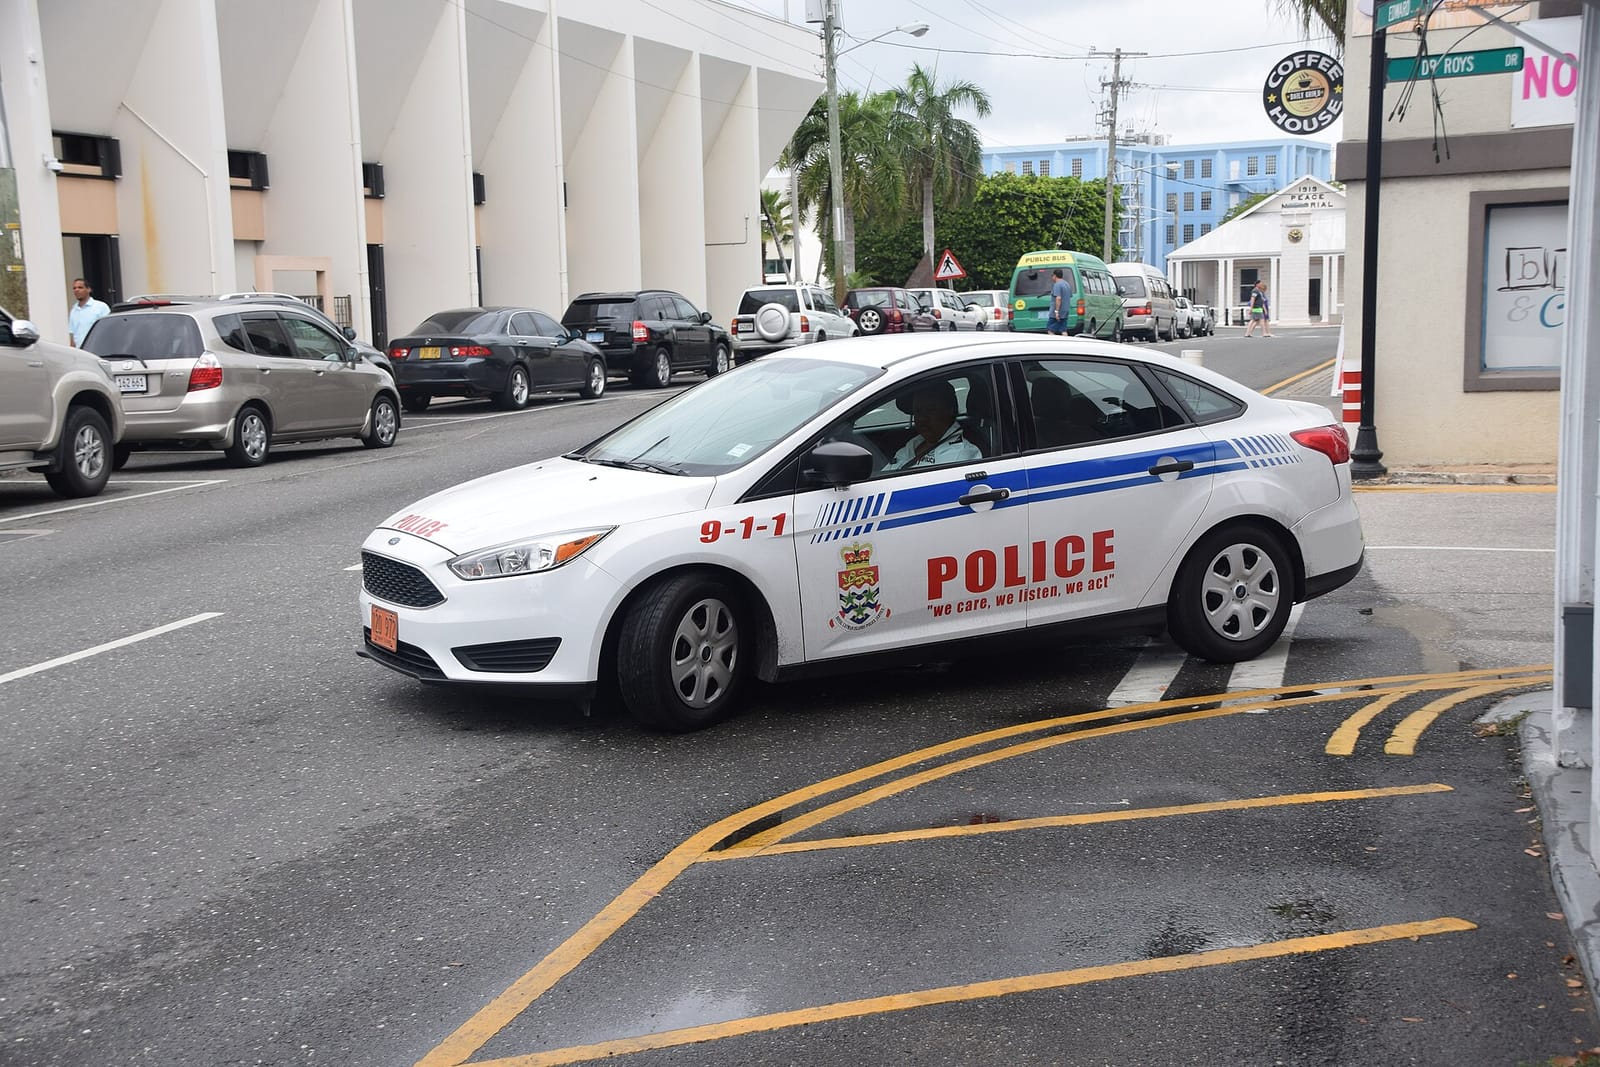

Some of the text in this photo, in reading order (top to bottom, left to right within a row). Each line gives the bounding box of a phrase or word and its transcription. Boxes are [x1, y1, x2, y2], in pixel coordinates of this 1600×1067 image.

[1267, 54, 1343, 89] COFFEE
[1443, 55, 1475, 74] ROYS
[1504, 53, 1518, 67] DR
[1522, 53, 1577, 100] NO
[1269, 99, 1343, 132] HOUSE
[1291, 193, 1324, 201] PEACE
[1025, 255, 1051, 263] PUBLIC
[391, 514, 449, 537] POLICE
[700, 512, 787, 543] 9-1-1
[927, 529, 1115, 601] POLICE
[957, 597, 991, 613] care,
[996, 593, 1014, 607] we
[1018, 585, 1061, 603] listen,
[1066, 581, 1084, 594] we
